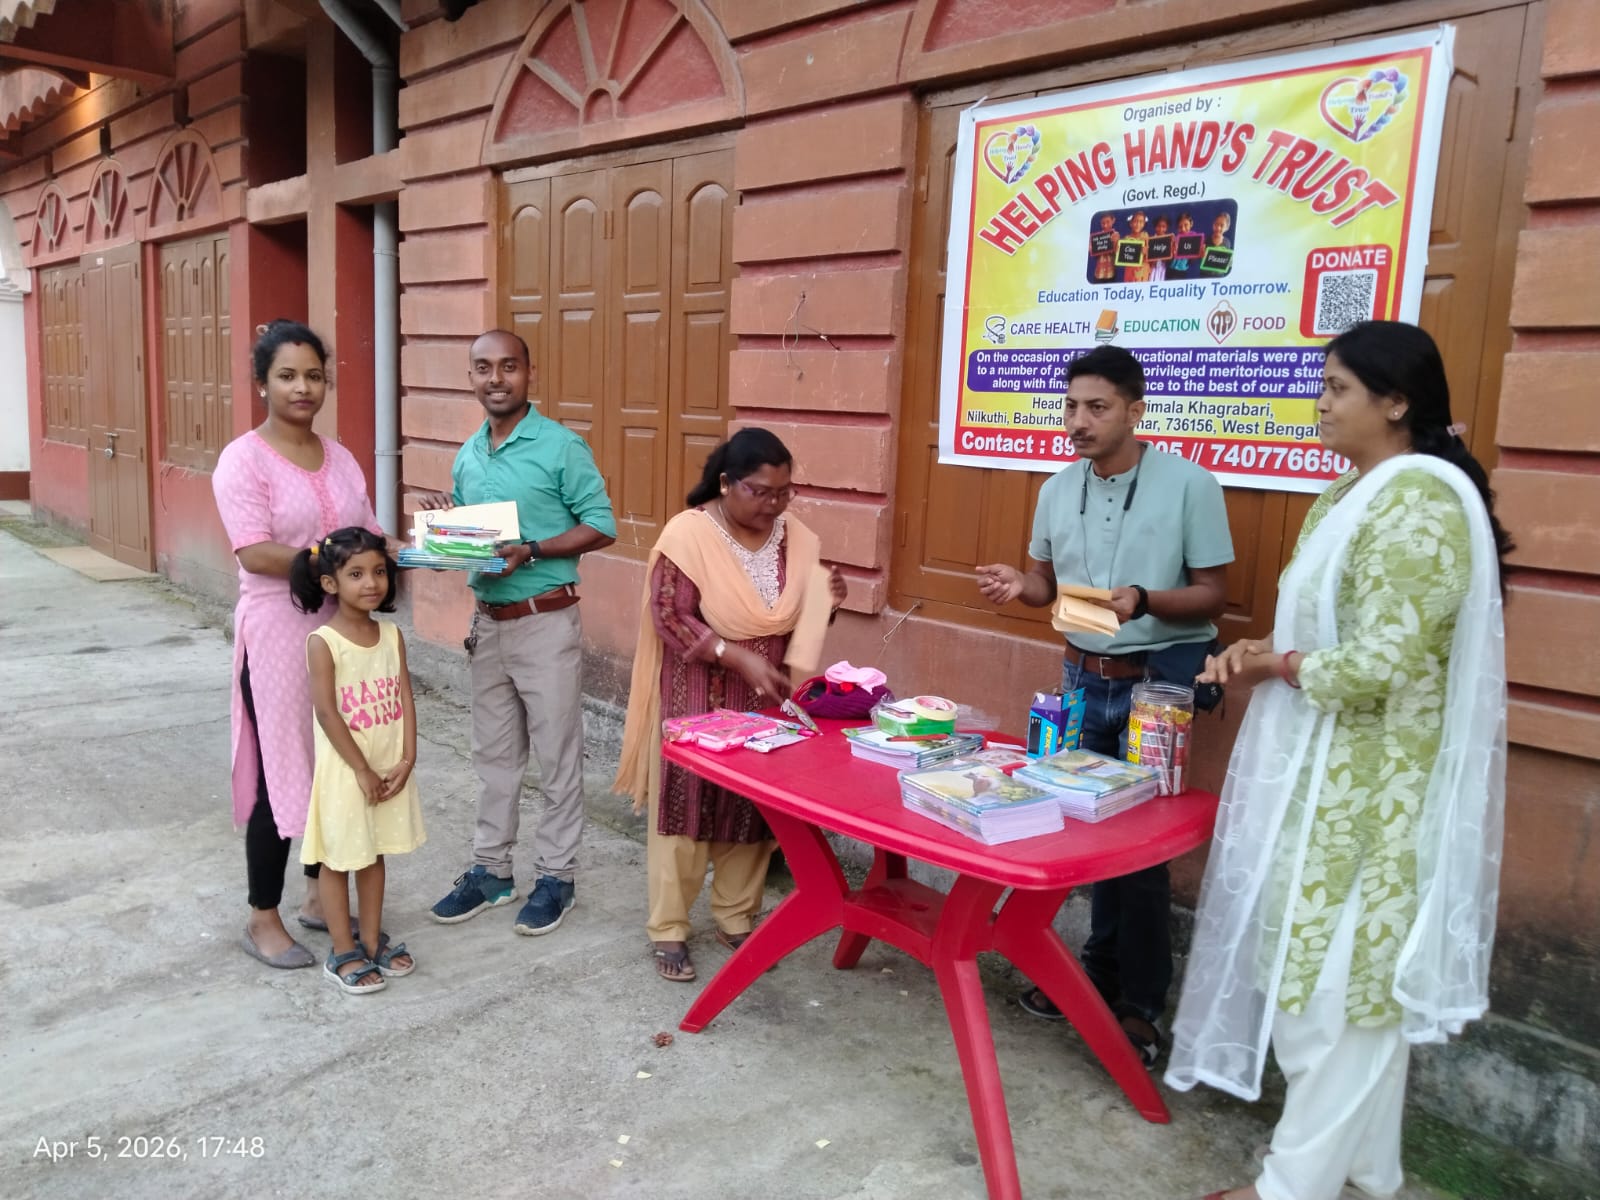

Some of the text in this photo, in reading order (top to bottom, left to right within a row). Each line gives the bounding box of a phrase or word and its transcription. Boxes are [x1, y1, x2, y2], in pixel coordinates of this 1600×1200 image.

[1123, 99, 1192, 123] Organised
[1195, 95, 1214, 112] by
[978, 120, 1400, 256] HELPING HAND'S TRUST
[1122, 181, 1206, 205] (Govt. Regd.)
[1153, 243, 1167, 252] Help
[1311, 248, 1388, 269] DONATE
[1037, 280, 1292, 304] Education Today, Equality Tomorrow.
[1010, 316, 1286, 335] CARE HEALTH EDUCATION FOOD
[976, 351, 991, 363] On
[993, 351, 1009, 362] the
[1011, 351, 1060, 363] occasion
[1062, 350, 1075, 362] of
[1196, 349, 1259, 362] materials
[1263, 352, 1298, 363] were
[1302, 352, 1325, 366] pro
[977, 365, 988, 376] to
[989, 367, 996, 376] a
[999, 365, 1038, 376] number
[1040, 365, 1052, 376] of
[1053, 367, 1067, 379] po
[1143, 365, 1206, 379] privileged
[1209, 365, 1290, 378] meritorious
[992, 378, 1021, 391] along
[1023, 378, 1046, 389] with
[1048, 378, 1068, 389] fina
[1167, 380, 1181, 392] to
[1184, 380, 1205, 392] the
[1208, 380, 1239, 393] best
[1241, 380, 1257, 393] of
[1259, 383, 1285, 393] our
[1287, 380, 1326, 394] abilit
[1032, 397, 1275, 418] Head imala Khagrabari,
[967, 411, 1010, 425] Nilkuthi,
[1013, 412, 1063, 426] Baburha
[1166, 417, 1217, 435] 736156,
[1222, 420, 1260, 435] West
[961, 431, 1034, 454] Contact
[1039, 440, 1046, 454] :
[1051, 435, 1076, 457] 89
[1209, 443, 1351, 475] 740776650
[348, 700, 403, 732] MIND
